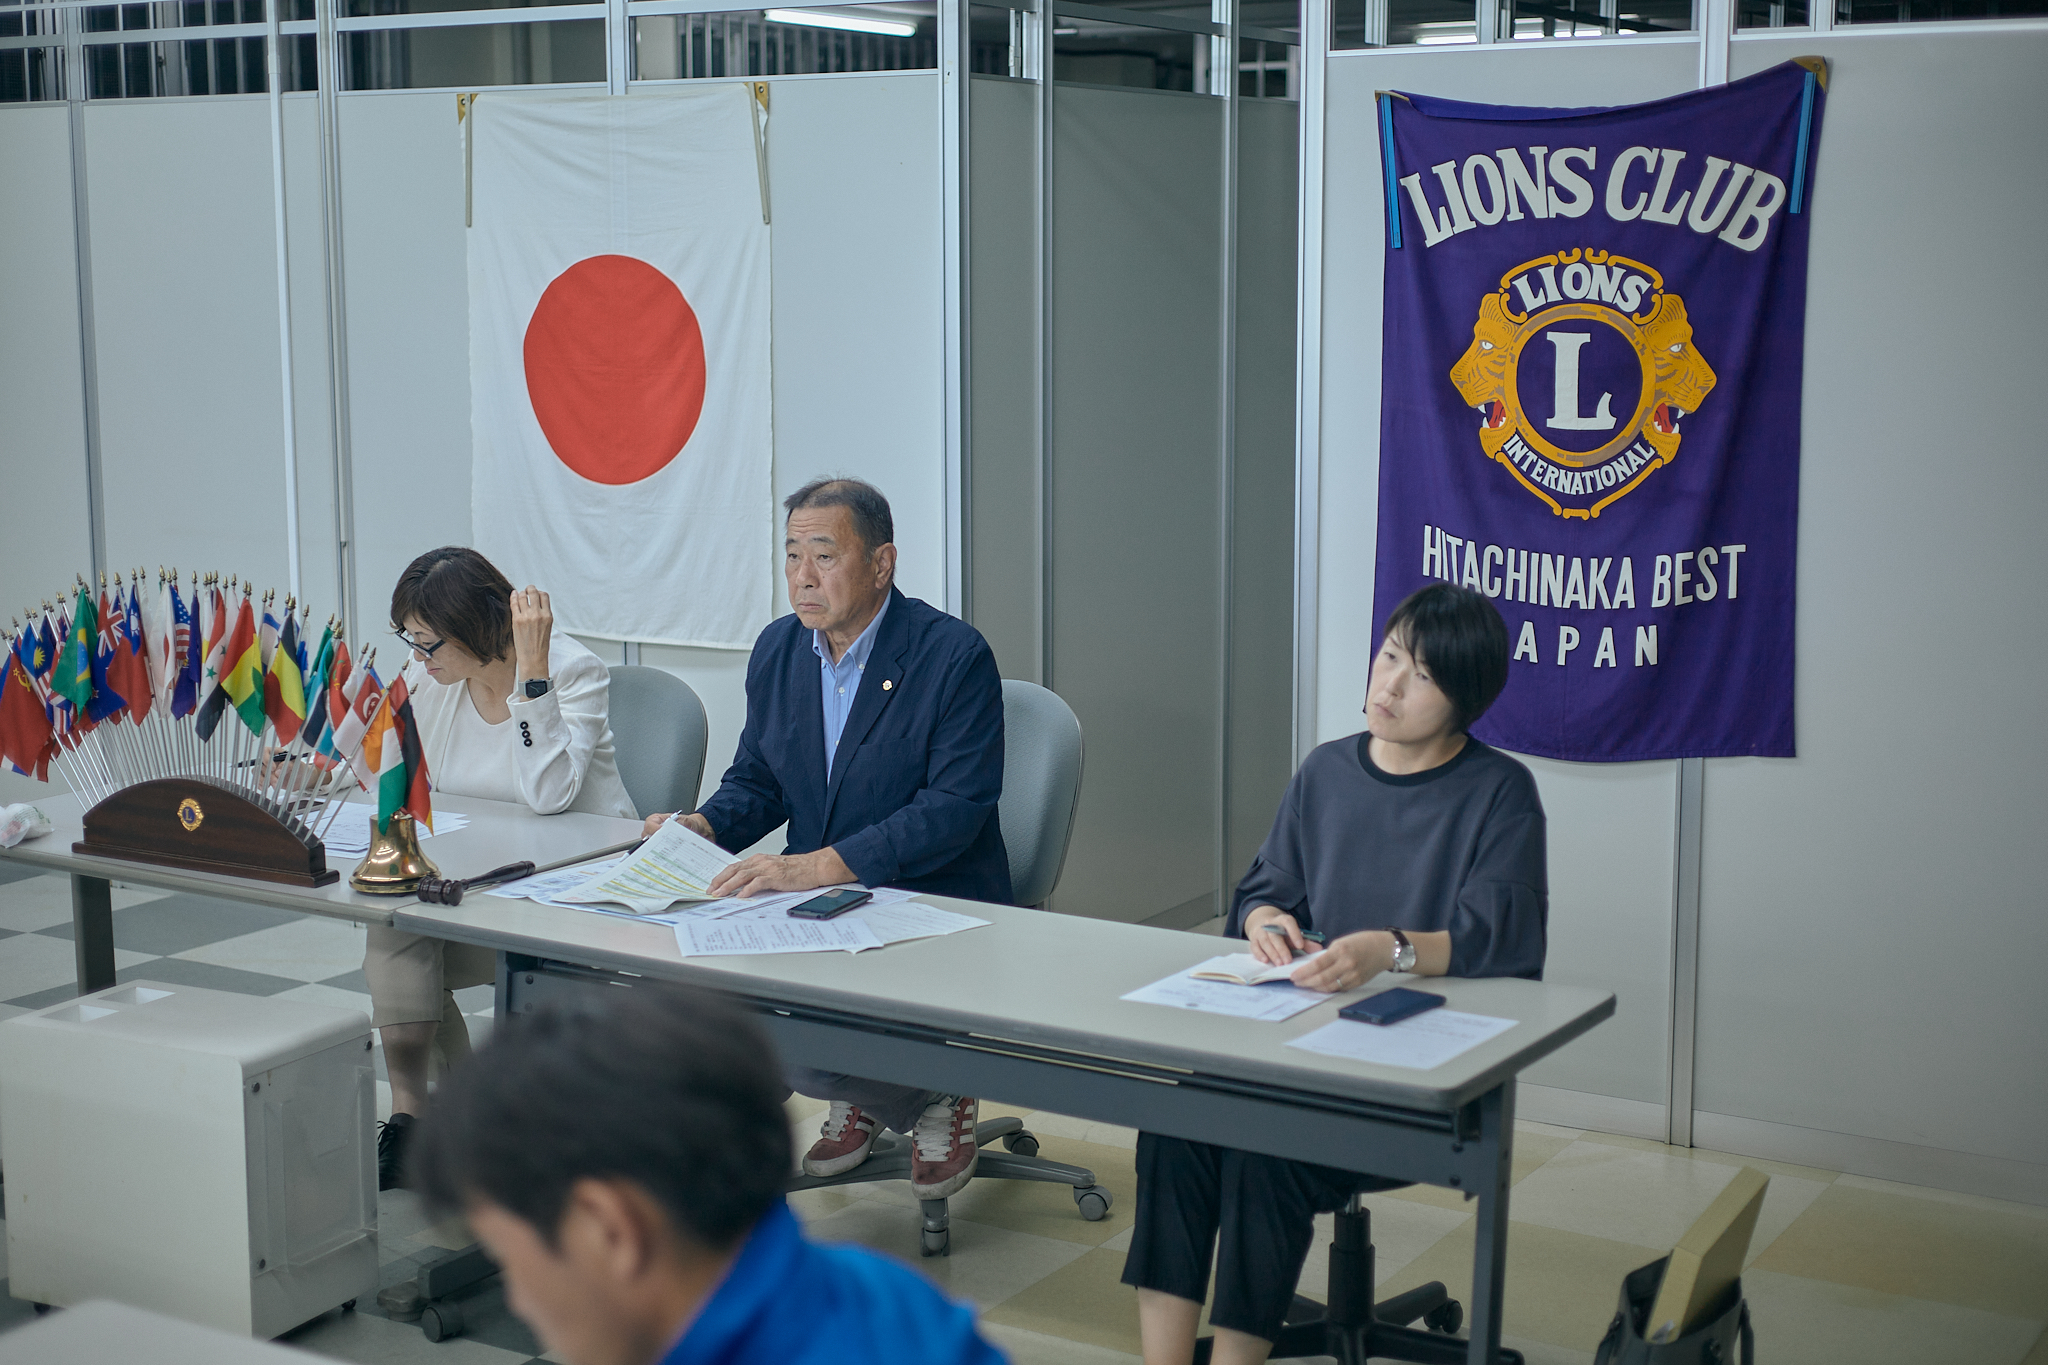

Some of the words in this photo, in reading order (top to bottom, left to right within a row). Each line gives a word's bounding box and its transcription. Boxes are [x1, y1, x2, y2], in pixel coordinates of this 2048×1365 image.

[1400, 146, 1597, 248] LIONS
[1605, 146, 1786, 252] CLUB
[1512, 263, 1652, 313] LIONS
[1546, 331, 1617, 431] L
[1503, 433, 1656, 495] INTERNATIONAL
[1422, 525, 1636, 610] HITACHINAKA
[1651, 544, 1747, 608] BEST
[1513, 621, 1658, 668] APAN
